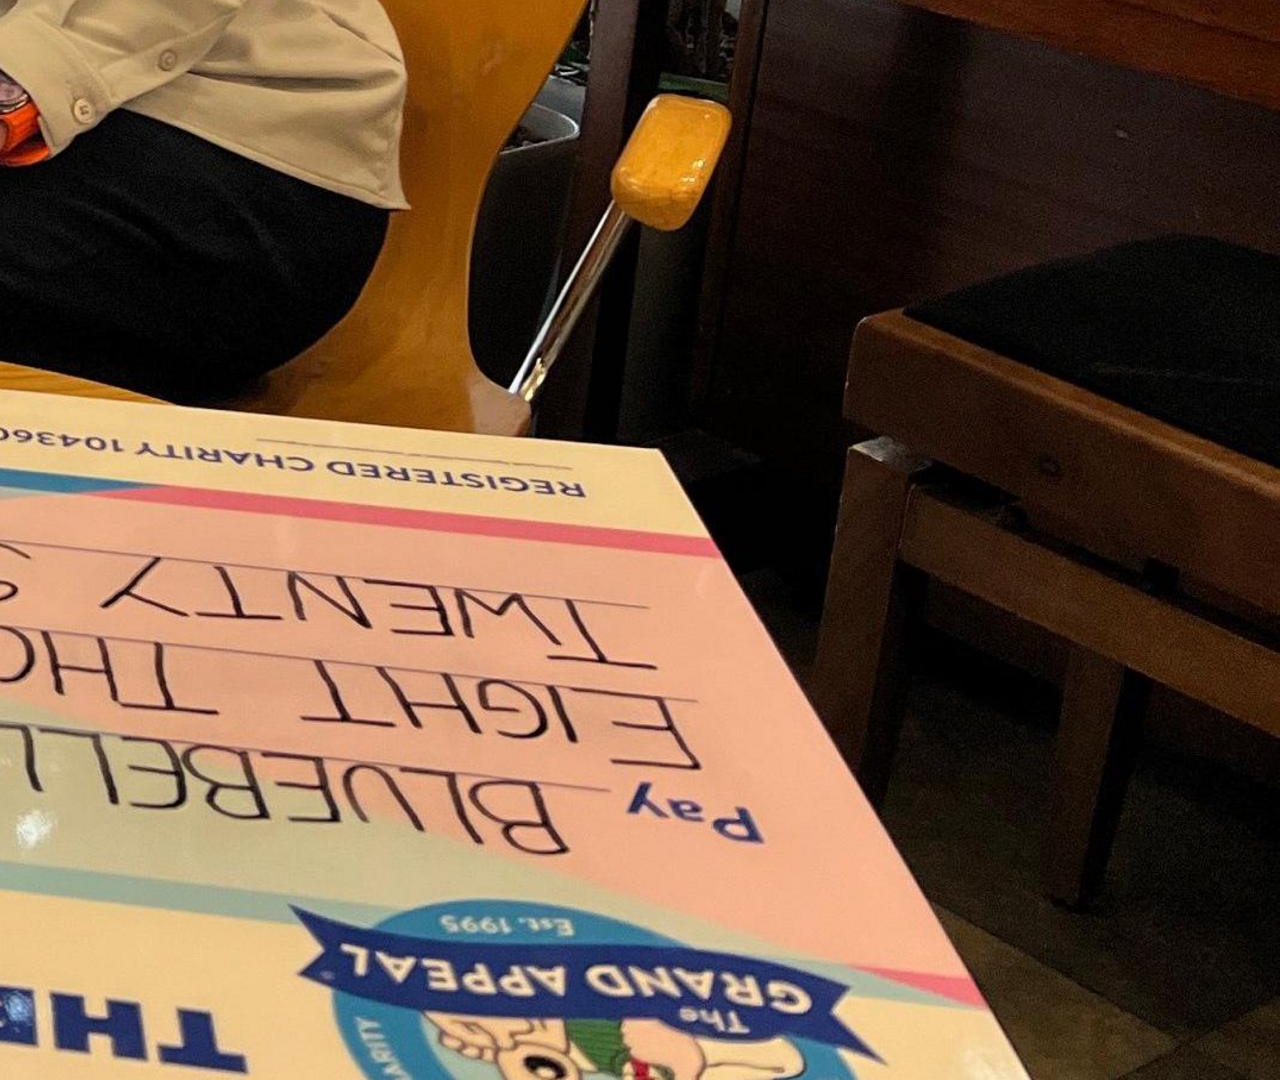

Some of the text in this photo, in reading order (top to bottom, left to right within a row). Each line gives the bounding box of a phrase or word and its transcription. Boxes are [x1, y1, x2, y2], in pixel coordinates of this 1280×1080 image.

[137, 442, 315, 473] CHARITY
[328, 460, 586, 498] REGISTERED
[99, 555, 658, 670] TWENTY
[300, 659, 702, 770] EIGHT
[626, 781, 765, 844] Pay
[439, 913, 576, 938] Est. 1995
[339, 941, 813, 1015] GRAND APPEAL
[678, 1006, 751, 1035] The
